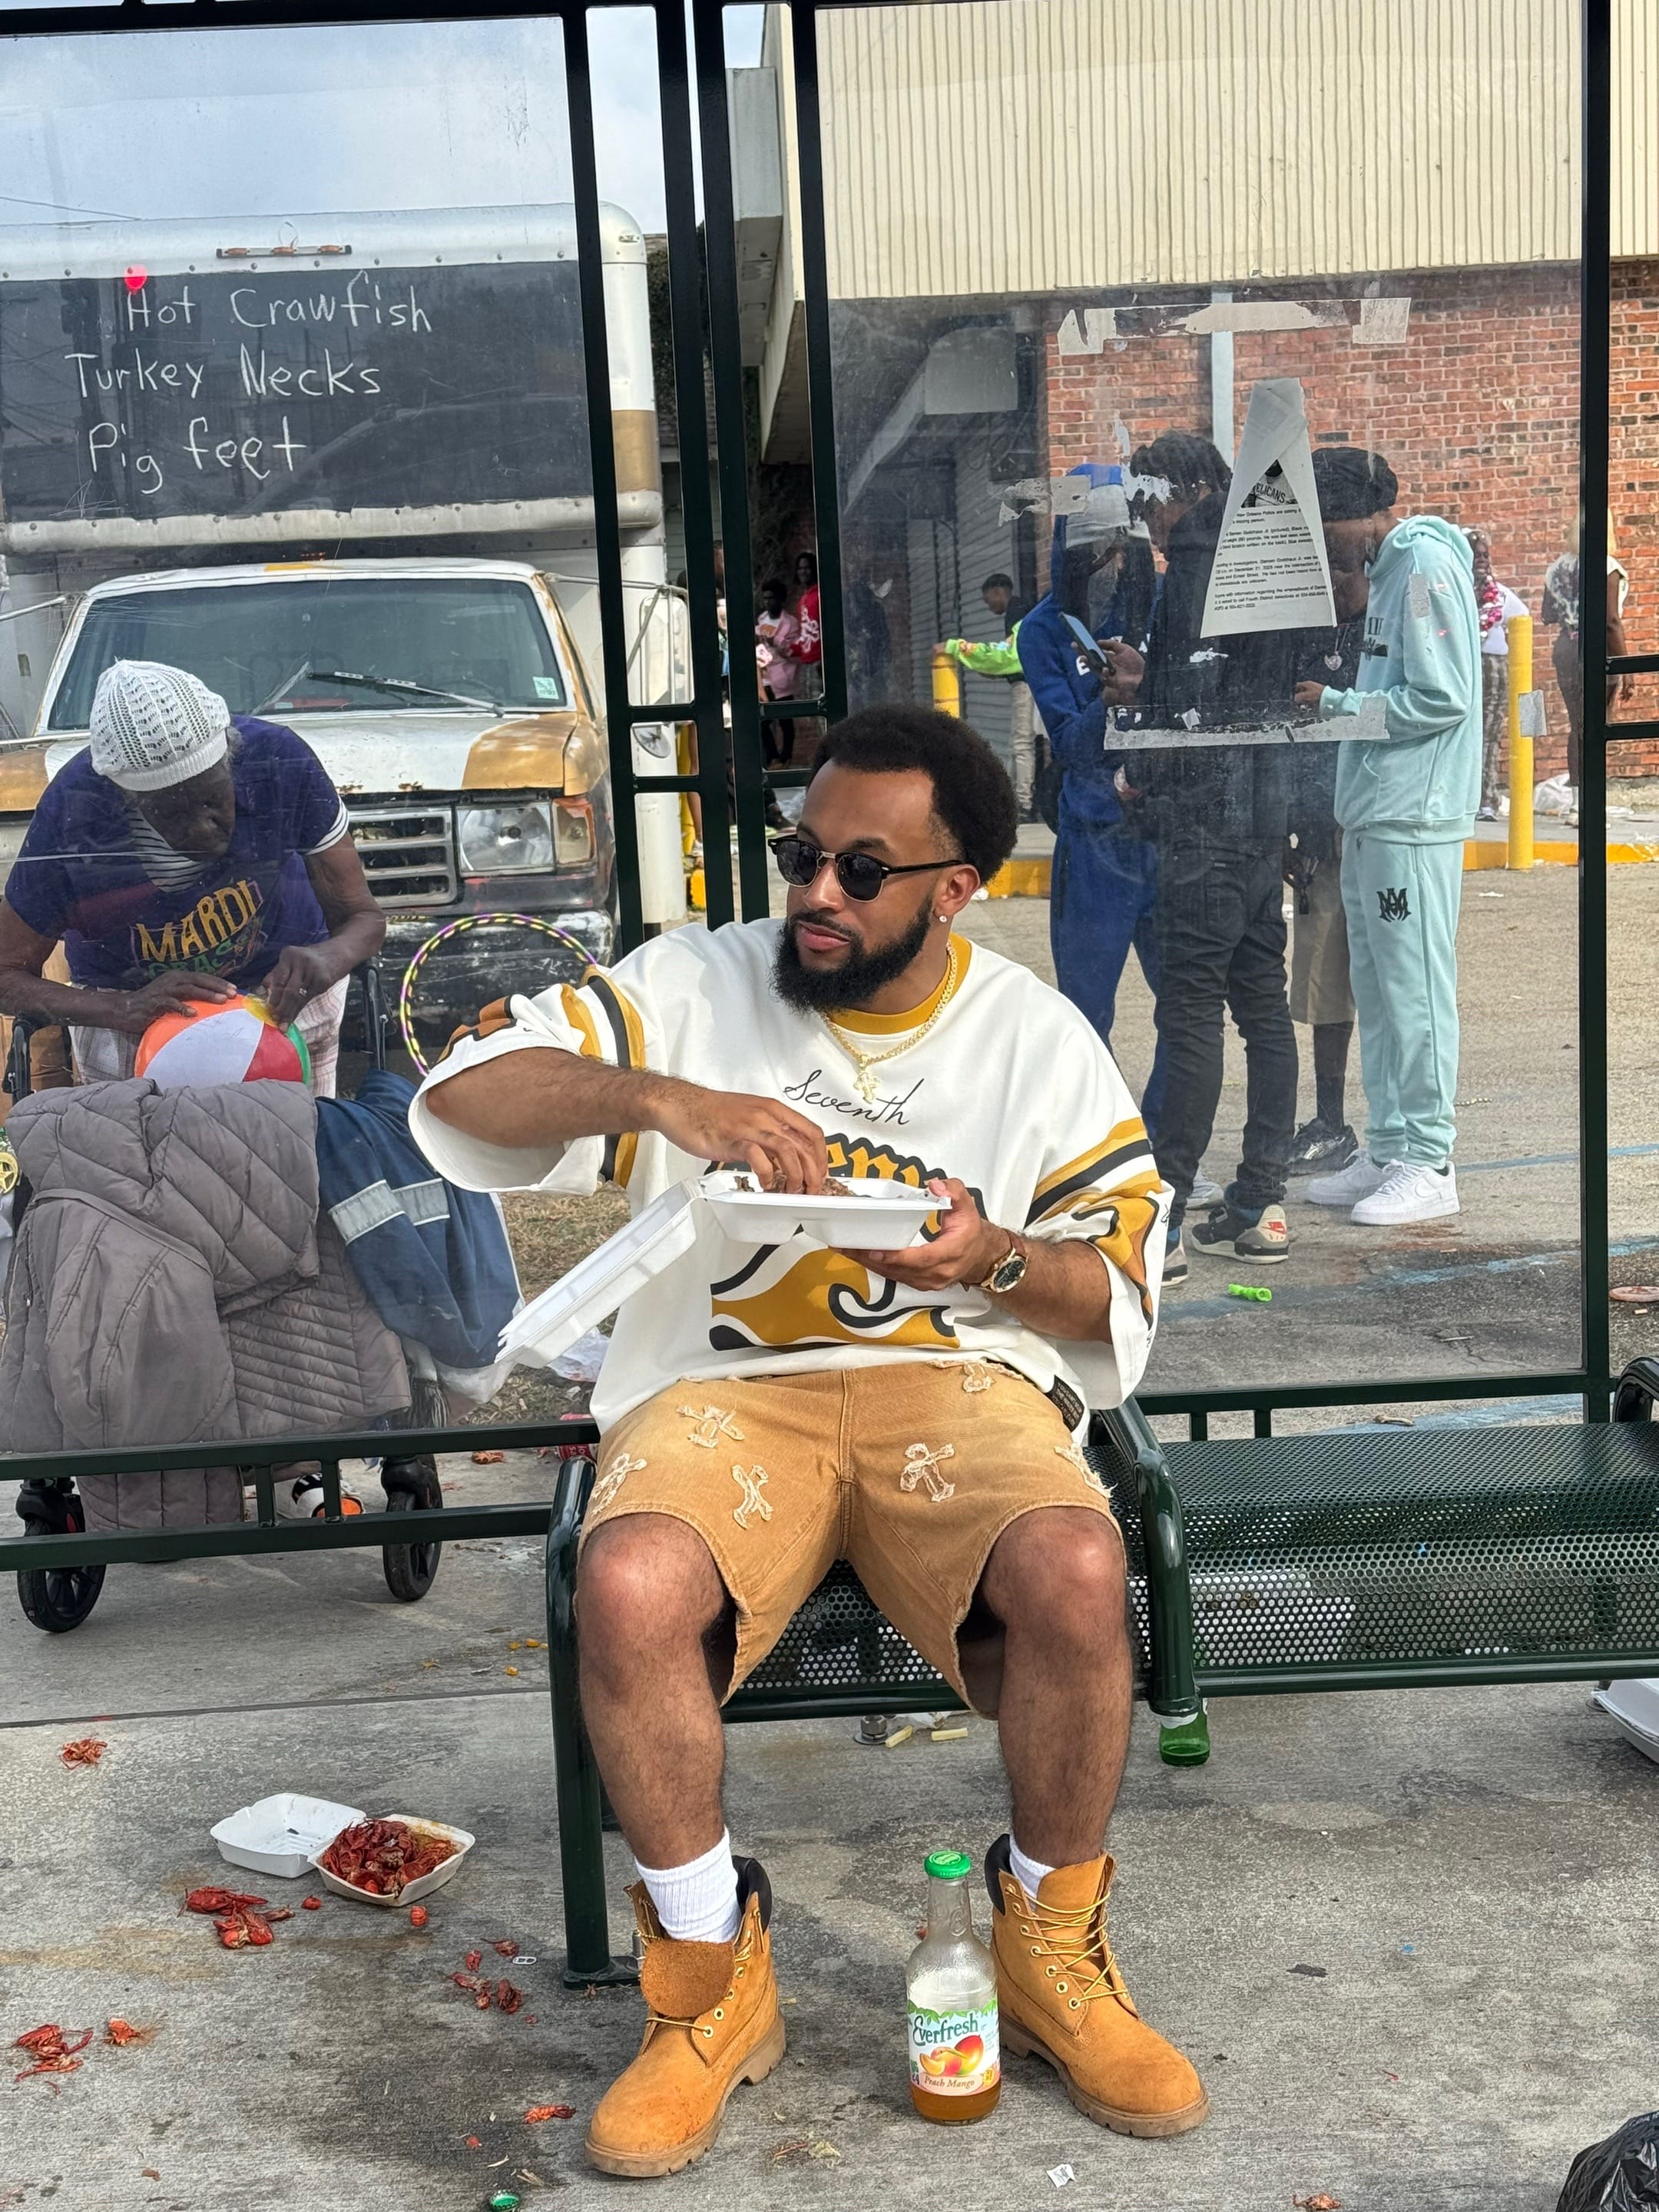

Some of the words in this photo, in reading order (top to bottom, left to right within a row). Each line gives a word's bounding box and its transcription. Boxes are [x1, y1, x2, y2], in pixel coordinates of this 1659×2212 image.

[126, 286, 196, 331] Hot
[230, 270, 432, 332] Crawfish
[65, 348, 204, 398] Turkey
[240, 343, 381, 398] Necks
[88, 422, 164, 494] Pig
[184, 416, 307, 479] feet
[1255, 482, 1286, 504] ELICANS
[136, 879, 257, 962] MARDI
[783, 1070, 924, 1126] Seventh
[912, 2012, 979, 2046] Everfresh
[924, 2075, 945, 2087] Peach
[947, 2079, 975, 2089] Mango
